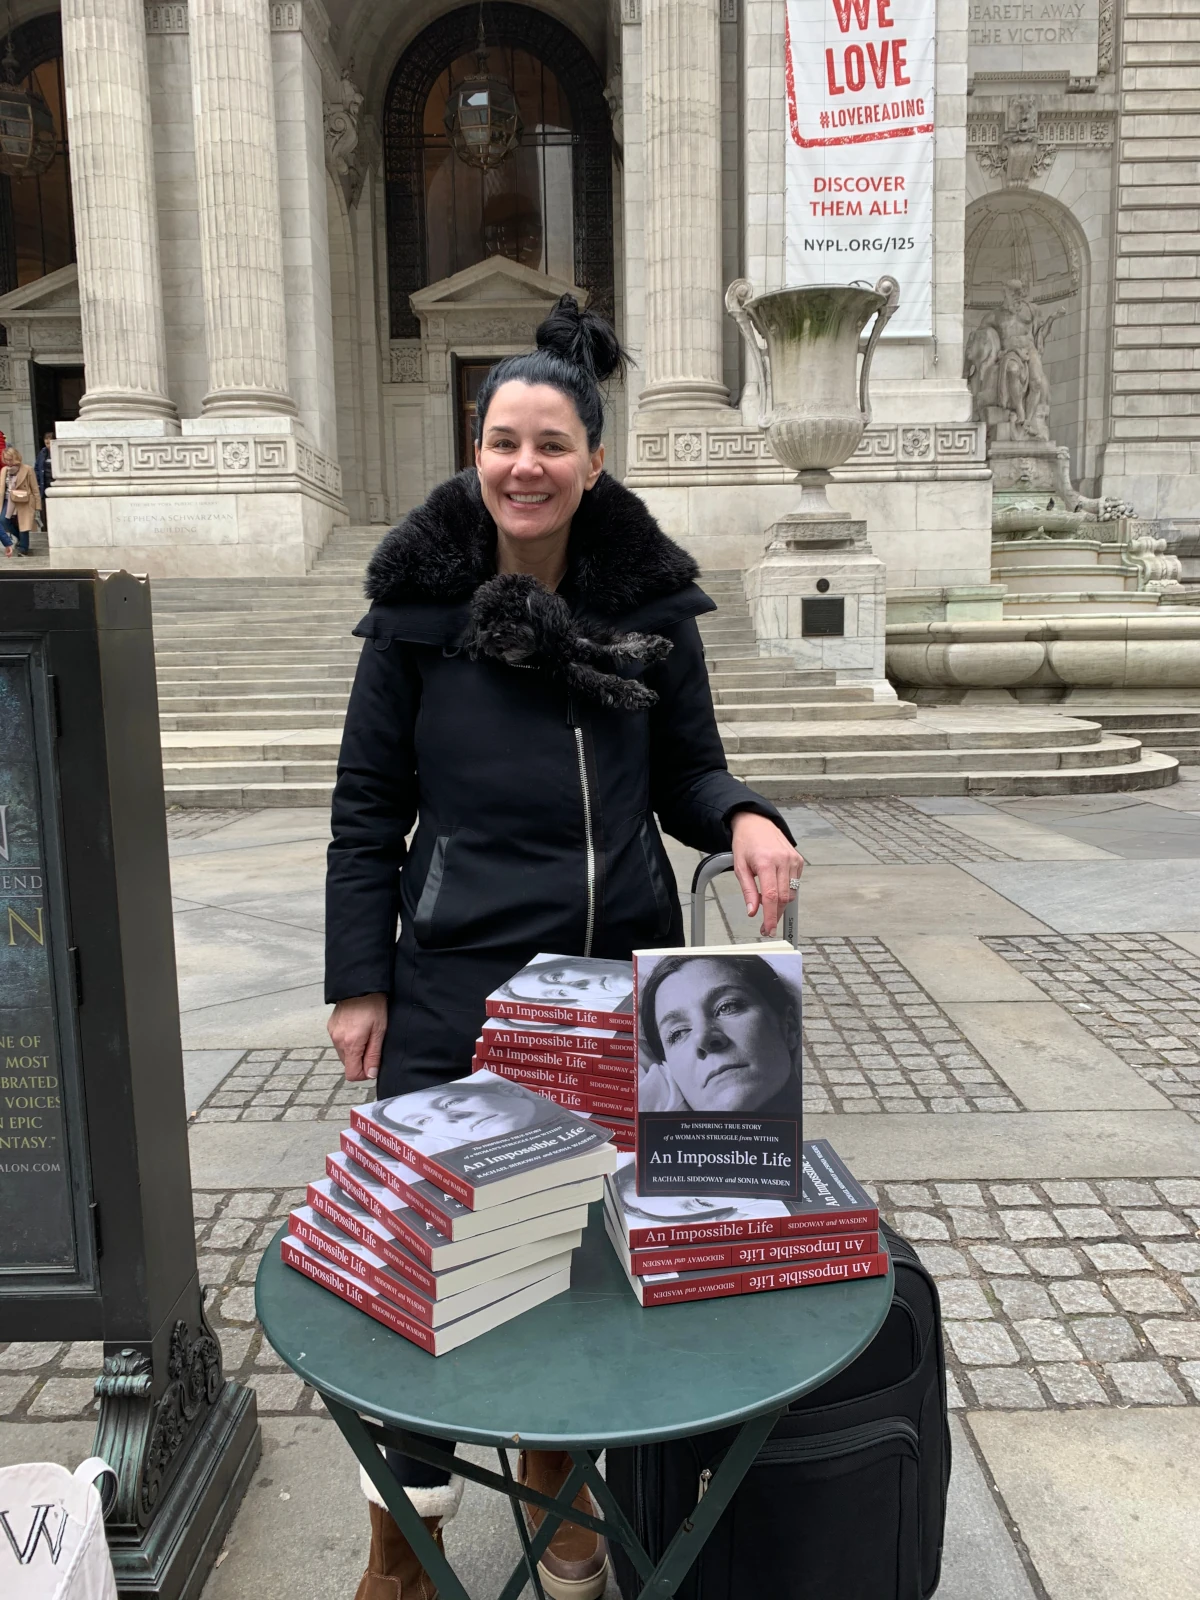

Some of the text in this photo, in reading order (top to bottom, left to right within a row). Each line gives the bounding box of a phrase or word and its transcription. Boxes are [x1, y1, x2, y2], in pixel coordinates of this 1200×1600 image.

[832, 0, 894, 33] WE
[1040, 4, 1085, 18] AWAY
[970, 27, 1078, 44] THE VICTORY
[826, 38, 910, 96] LOVE
[820, 98, 924, 128] #LOVEREADING
[814, 176, 905, 192] DISCOVER
[810, 198, 908, 216] THEM ALL!
[804, 236, 914, 252] NYPL.ORG/125
[498, 1003, 513, 1014] An
[516, 1004, 573, 1020] Impossible
[576, 1012, 597, 1023] Life
[20, 1036, 41, 1048] OF
[494, 1032, 511, 1042] An
[513, 1033, 573, 1048] Impossible
[576, 1038, 598, 1050] Life
[6, 1056, 49, 1068] MOST
[488, 1046, 503, 1058] An
[506, 1048, 563, 1066] Impossible
[566, 1056, 587, 1069] Life
[598, 1064, 629, 1072] SIDDOWAY
[0, 1076, 58, 1088] BRATED
[482, 1062, 497, 1073] An
[500, 1064, 555, 1082] Impossible
[558, 1073, 579, 1086] Life
[589, 1081, 619, 1090] SIDDOWAY
[5, 1096, 60, 1108] VOICES
[560, 1093, 581, 1106] Life
[592, 1101, 622, 1110] SIDDOWAY
[10, 1117, 42, 1128] EPIC
[356, 1117, 366, 1131] An
[367, 1121, 401, 1154] Impossible
[402, 1146, 416, 1165] Life
[463, 1126, 586, 1173] An Impossible Life
[345, 1141, 355, 1153] An
[355, 1147, 386, 1184] Impossible
[387, 1173, 400, 1192] Life
[650, 1150, 791, 1168] An Impossible Life
[760, 1178, 790, 1186] WASDEN
[330, 1164, 339, 1177] An
[339, 1171, 369, 1206] Impossible
[370, 1199, 381, 1218] Life
[825, 1196, 840, 1206] An
[313, 1193, 324, 1209] An
[324, 1200, 361, 1237] Impossible
[362, 1228, 377, 1248] Life
[645, 1231, 666, 1242] An
[670, 1224, 743, 1242] Impossible
[748, 1221, 774, 1234] Life
[769, 1240, 840, 1259] Impossible
[845, 1239, 864, 1248] An
[642, 1259, 672, 1267] WASDEN
[687, 1254, 724, 1264] SIDDOWAY
[739, 1249, 765, 1262] Life
[296, 1222, 426, 1314] An Impossible Life SIDDOWAY and WASDEN
[779, 1264, 848, 1283] Impossible
[852, 1262, 872, 1274] An
[698, 1282, 735, 1292] SIDDOWAY
[749, 1275, 775, 1289] Life
[288, 1250, 427, 1341] An Impossible Life SIDDOWAY and WASDEN
[653, 1290, 683, 1299] WASDEN
